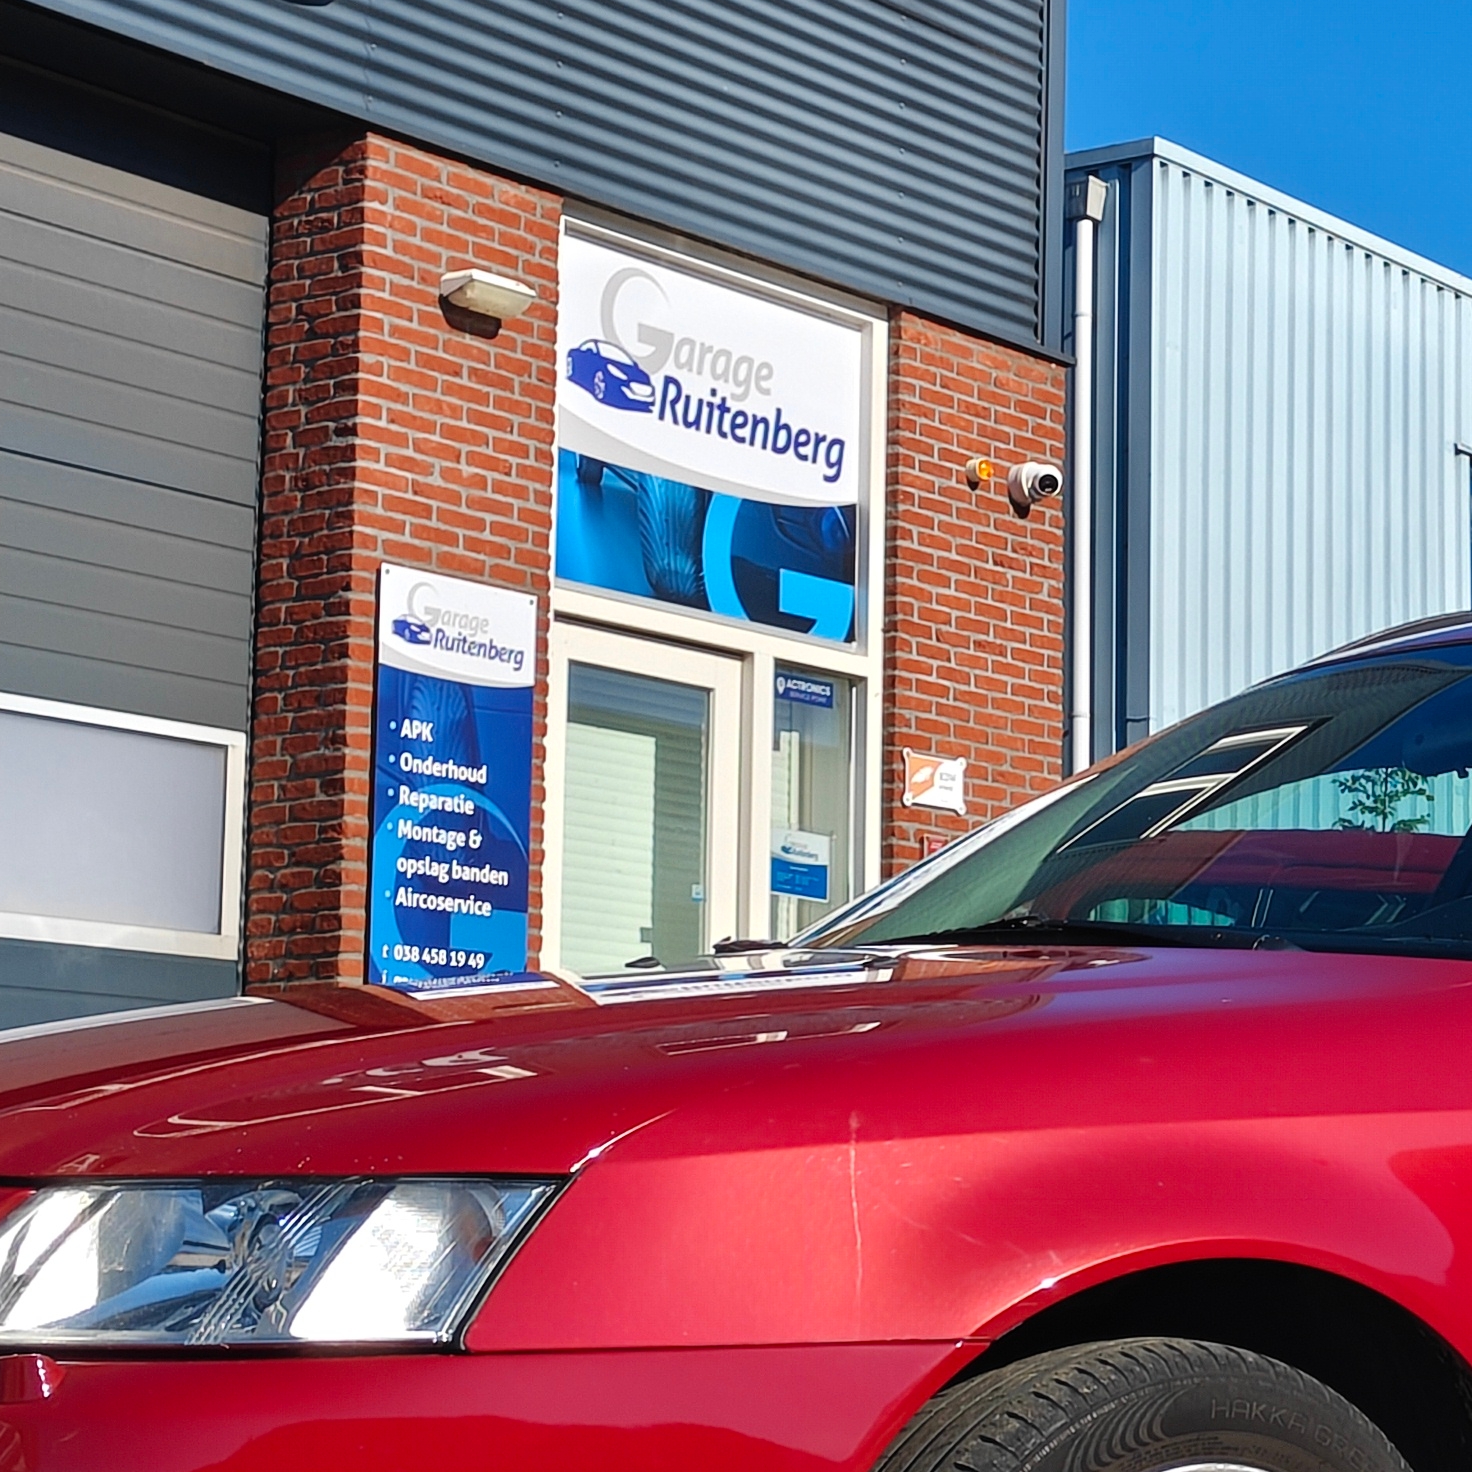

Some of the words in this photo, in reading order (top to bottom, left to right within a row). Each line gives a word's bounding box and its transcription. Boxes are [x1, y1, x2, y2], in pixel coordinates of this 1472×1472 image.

[600, 267, 774, 402] Garage
[658, 375, 846, 483] Ruitenberg
[407, 582, 489, 637] Garage
[434, 628, 525, 671] Ruitenberg
[400, 718, 434, 743] APK
[399, 752, 488, 784] Onderhoud
[399, 785, 475, 815] Reparatie
[397, 819, 466, 851] Montage
[468, 829, 482, 849] &
[396, 856, 450, 883] opslag
[452, 859, 509, 886] banden
[395, 886, 492, 916] Aircoservice
[393, 944, 420, 962] 038
[421, 947, 447, 965] 458
[449, 950, 466, 967] 19
[467, 952, 485, 969] 49
[1211, 1399, 1305, 1435] HAKKA
